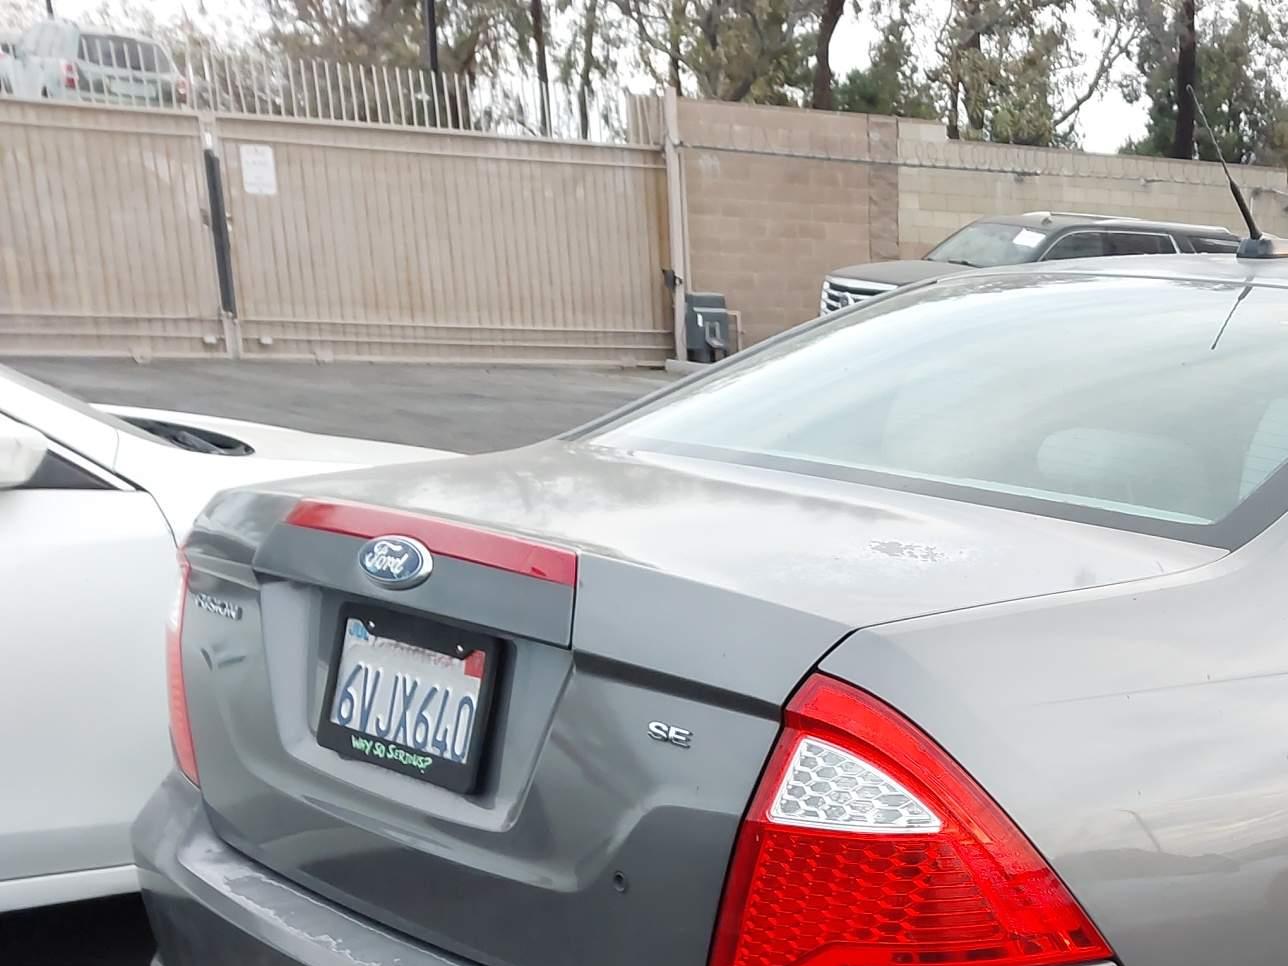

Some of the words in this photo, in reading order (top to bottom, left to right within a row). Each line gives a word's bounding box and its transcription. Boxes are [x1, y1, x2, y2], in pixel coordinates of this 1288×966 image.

[365, 540, 409, 575] Ford
[337, 663, 475, 763] 6VJX640
[351, 734, 373, 756] WHY
[372, 741, 386, 759] SO
[648, 720, 692, 748] SE
